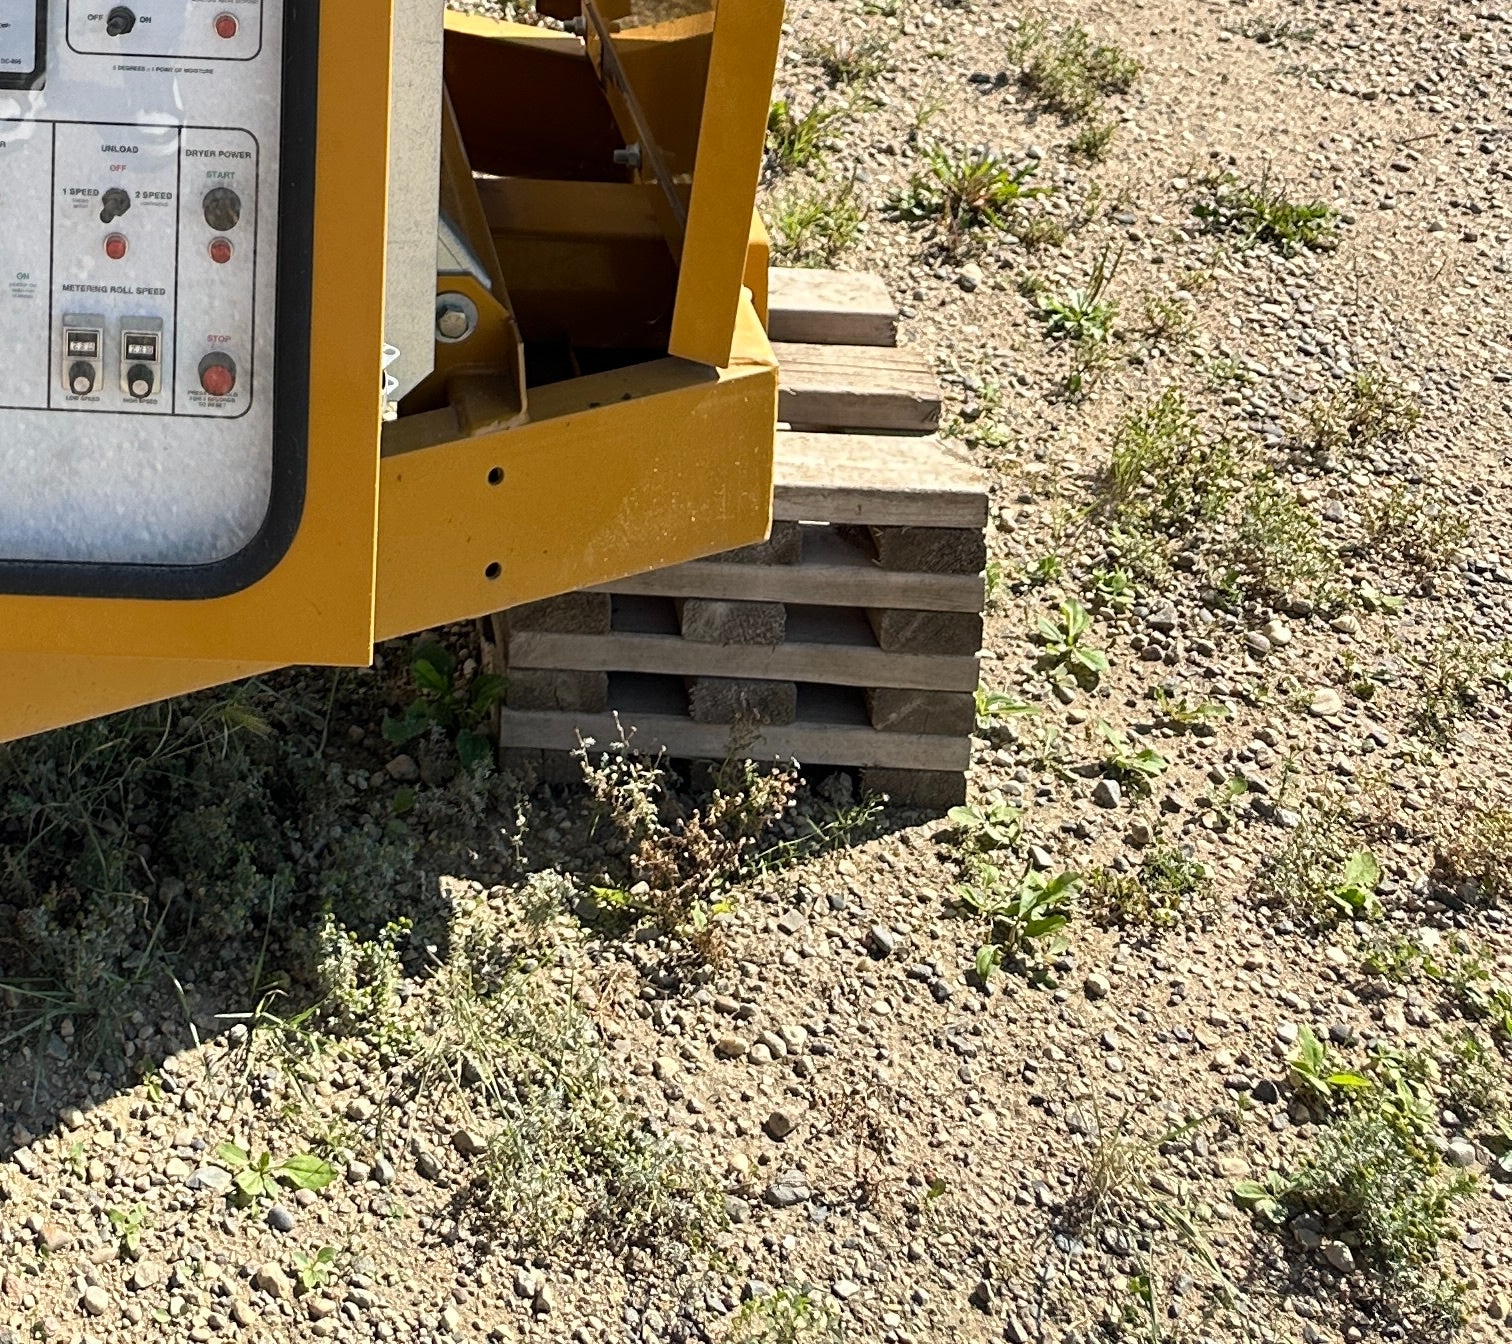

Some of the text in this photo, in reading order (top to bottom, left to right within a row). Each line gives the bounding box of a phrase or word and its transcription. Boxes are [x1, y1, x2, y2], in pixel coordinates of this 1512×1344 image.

[101, 145, 138, 153] UNLOAD
[186, 150, 252, 159] DRYER POWER
[206, 171, 235, 179] START
[143, 191, 172, 200] SPEED
[16, 272, 29, 280] ON
[62, 284, 166, 295] METERING ROLL SPEED
[207, 335, 231, 343] STOP
